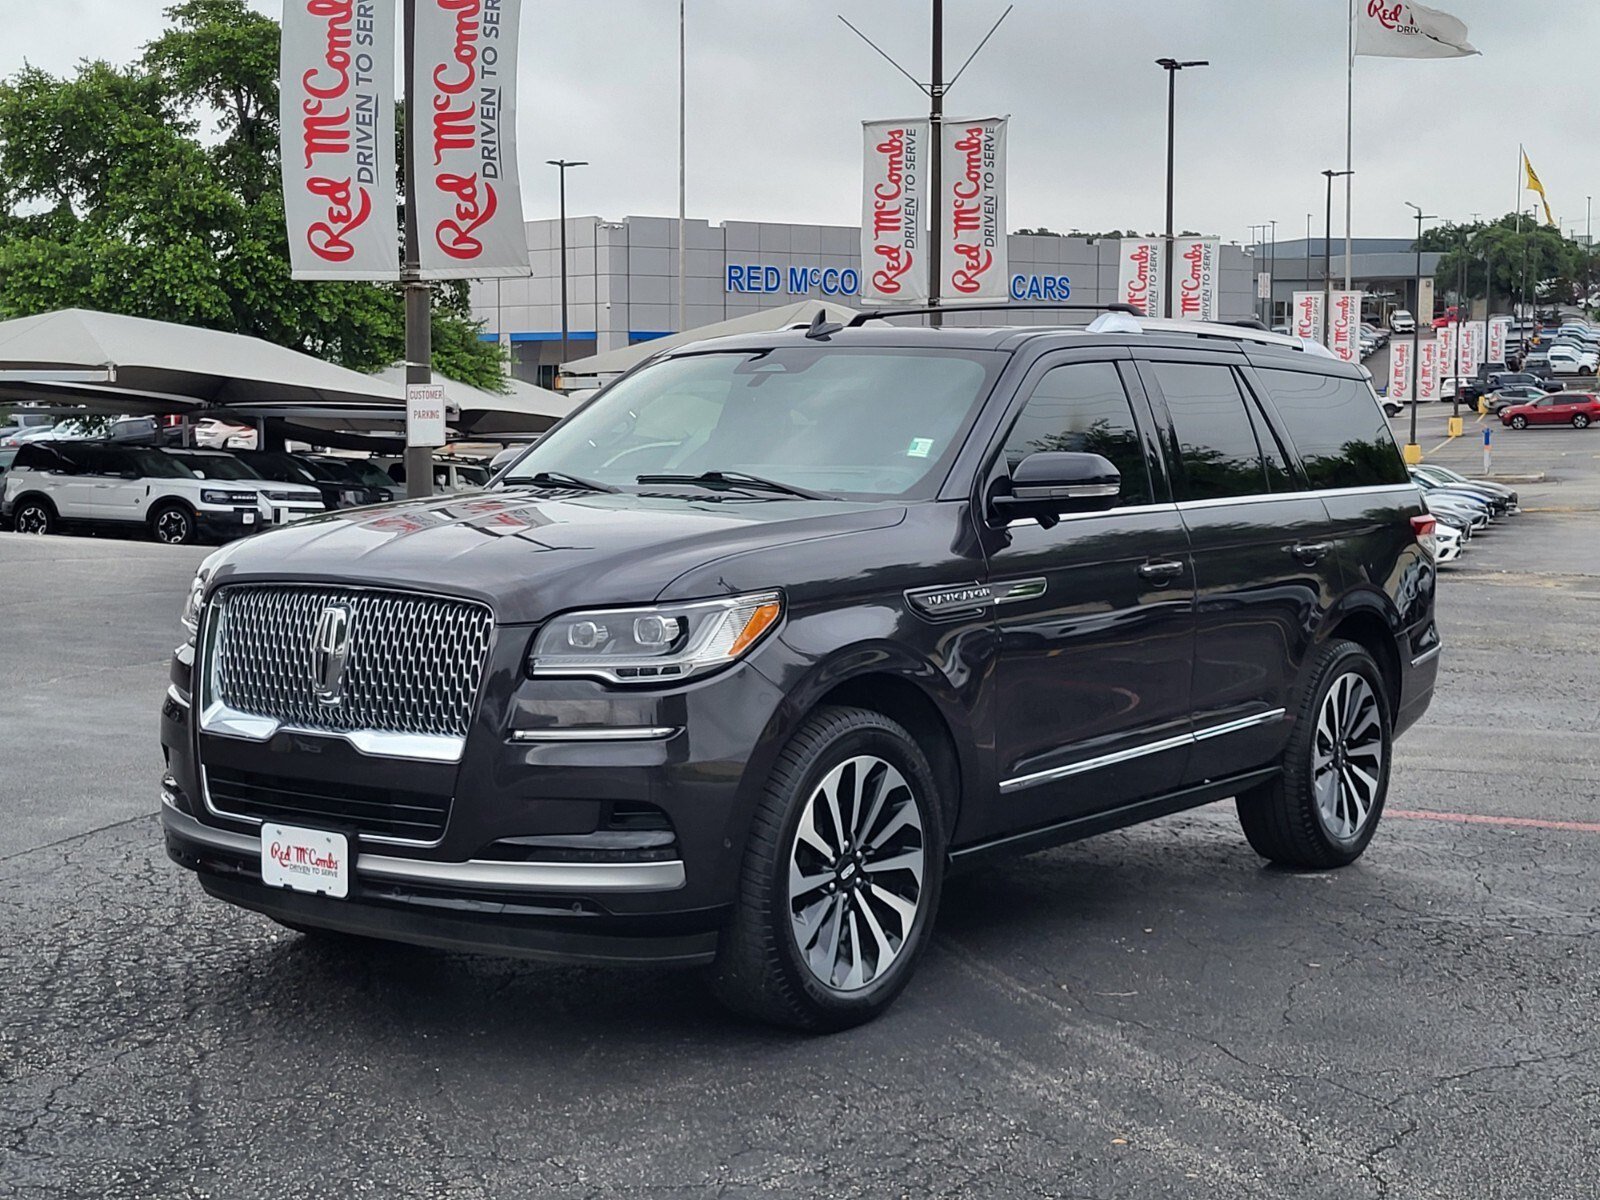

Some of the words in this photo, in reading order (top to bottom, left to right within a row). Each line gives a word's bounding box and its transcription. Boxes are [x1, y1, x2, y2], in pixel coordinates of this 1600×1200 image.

[355, 0, 374, 46] SER
[1367, 0, 1402, 29] Red
[355, 54, 373, 86] TO
[480, 46, 498, 81] TO
[356, 93, 374, 184] DRIVEN
[480, 88, 498, 179] DRIVEN
[905, 128, 917, 170] SERVE
[984, 127, 995, 168] SERVE
[874, 129, 904, 241] McCombs
[905, 174, 916, 192] TO
[953, 127, 983, 240] McCombs
[984, 172, 995, 191] TO
[307, 177, 371, 262] Red
[435, 172, 497, 260] Red
[904, 197, 917, 250] DRIVEN
[984, 196, 996, 248] DRIVEN
[872, 244, 913, 294] Red
[951, 243, 992, 293] Red
[1149, 244, 1158, 273] SERVE
[1203, 243, 1212, 272] SERVE
[727, 264, 781, 293] RED
[1011, 274, 1071, 300] CARS
[1149, 275, 1157, 287] TO
[1181, 243, 1203, 318] McCombs
[1203, 273, 1210, 286] TO
[410, 390, 442, 400] CUSTOMER
[413, 410, 440, 420] PARKING
[271, 841, 292, 867] Red
[292, 845, 340, 870] McCombs
[289, 864, 310, 874] DRIVEN
[312, 867, 320, 875] TO
[321, 869, 338, 878] SERVE
